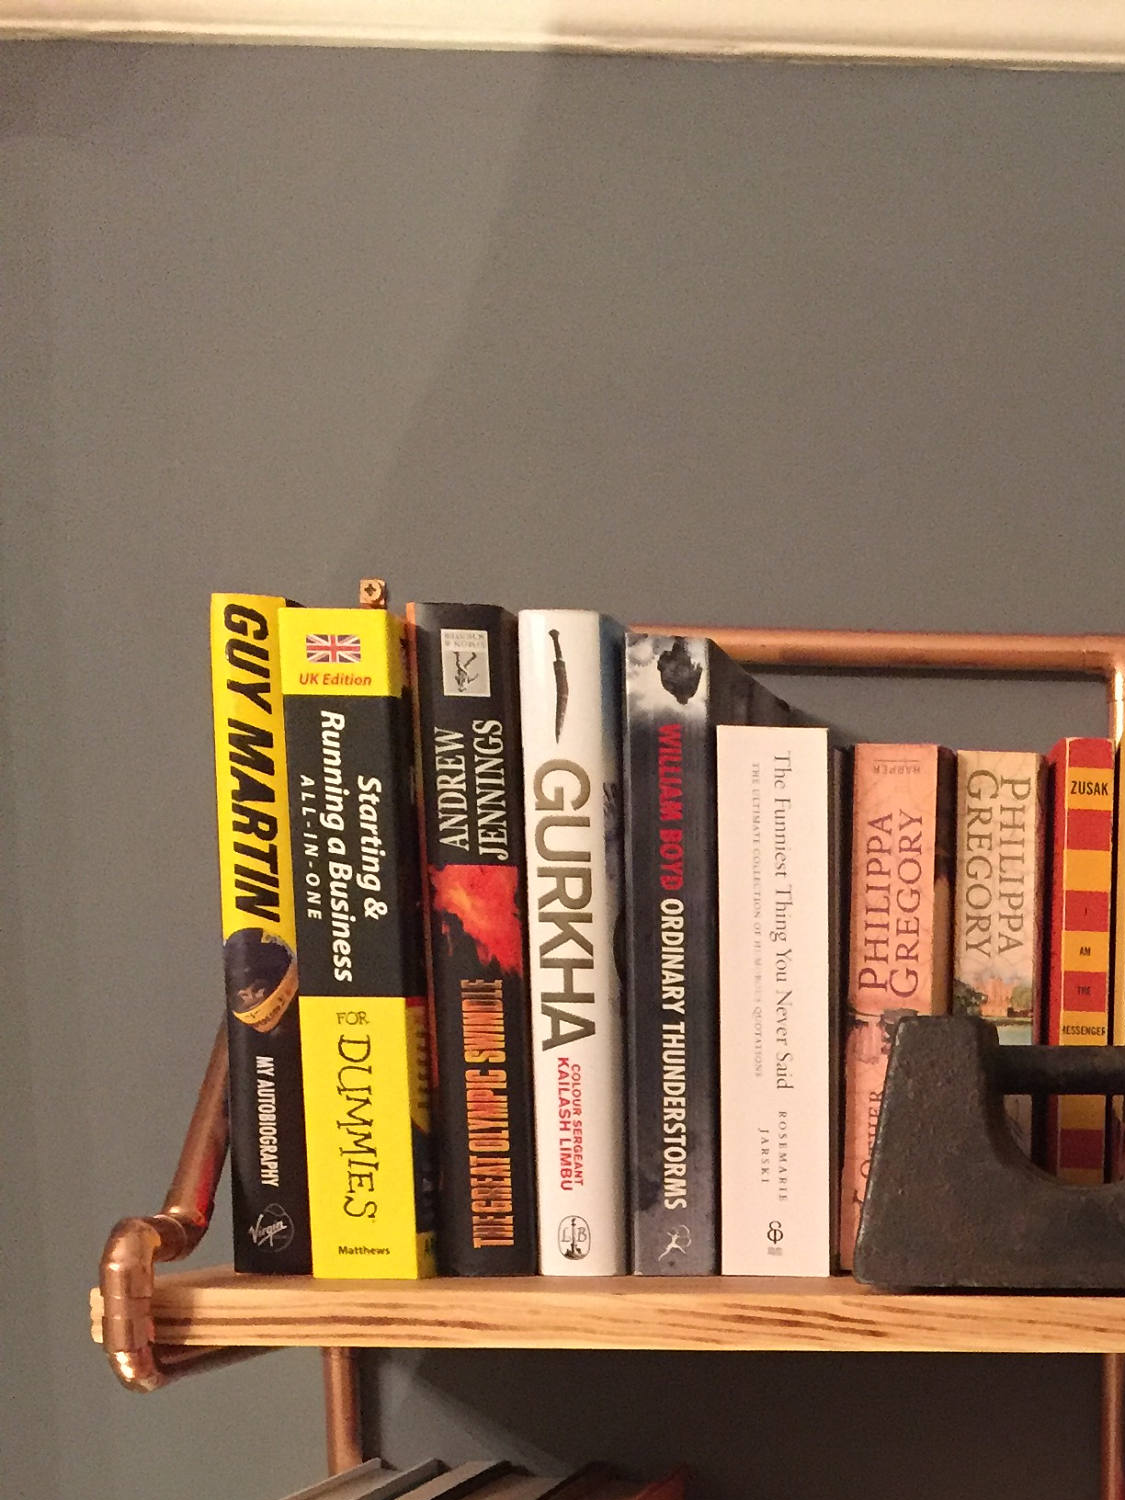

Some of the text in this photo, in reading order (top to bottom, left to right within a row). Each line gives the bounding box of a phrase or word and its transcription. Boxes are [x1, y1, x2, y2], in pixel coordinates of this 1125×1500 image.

[299, 673, 372, 686] UK Edition
[224, 603, 281, 923] GUY MARTIN
[434, 727, 470, 851] ANDREW
[472, 719, 509, 861] JENNINGS
[1071, 781, 1109, 796] ZUSAK
[300, 774, 322, 920] ALL-IN-ONE
[320, 710, 356, 982] Running a Business
[357, 775, 388, 919] Starting &
[533, 758, 596, 1052] GURKHA
[858, 813, 893, 992] PHILIPPA
[889, 808, 923, 998] GREGORY
[965, 769, 999, 958] GREGORY
[998, 776, 1031, 955] PHILIPPA
[657, 723, 687, 1210] WILLIAM BOYD ORDINARY THUNDERSTORMS
[769, 750, 794, 1089] The Funniest Thing You Never Said
[337, 1011, 370, 1025] FOR
[256, 1056, 279, 1188] MY AUTOBIOGRAPHY
[337, 1034, 379, 1220] DUMMIES
[460, 979, 514, 1248] THE GREAT OLYMPIC SWINDLE
[557, 1056, 573, 1191] KAILASH LIMBU
[571, 1063, 584, 1186] COLOUR SERGEANT
[759, 1128, 771, 1183] JARSKI
[777, 1110, 788, 1202] ROSEMARIE
[248, 1213, 287, 1247] Virgin
[338, 1245, 390, 1256] Matthews
